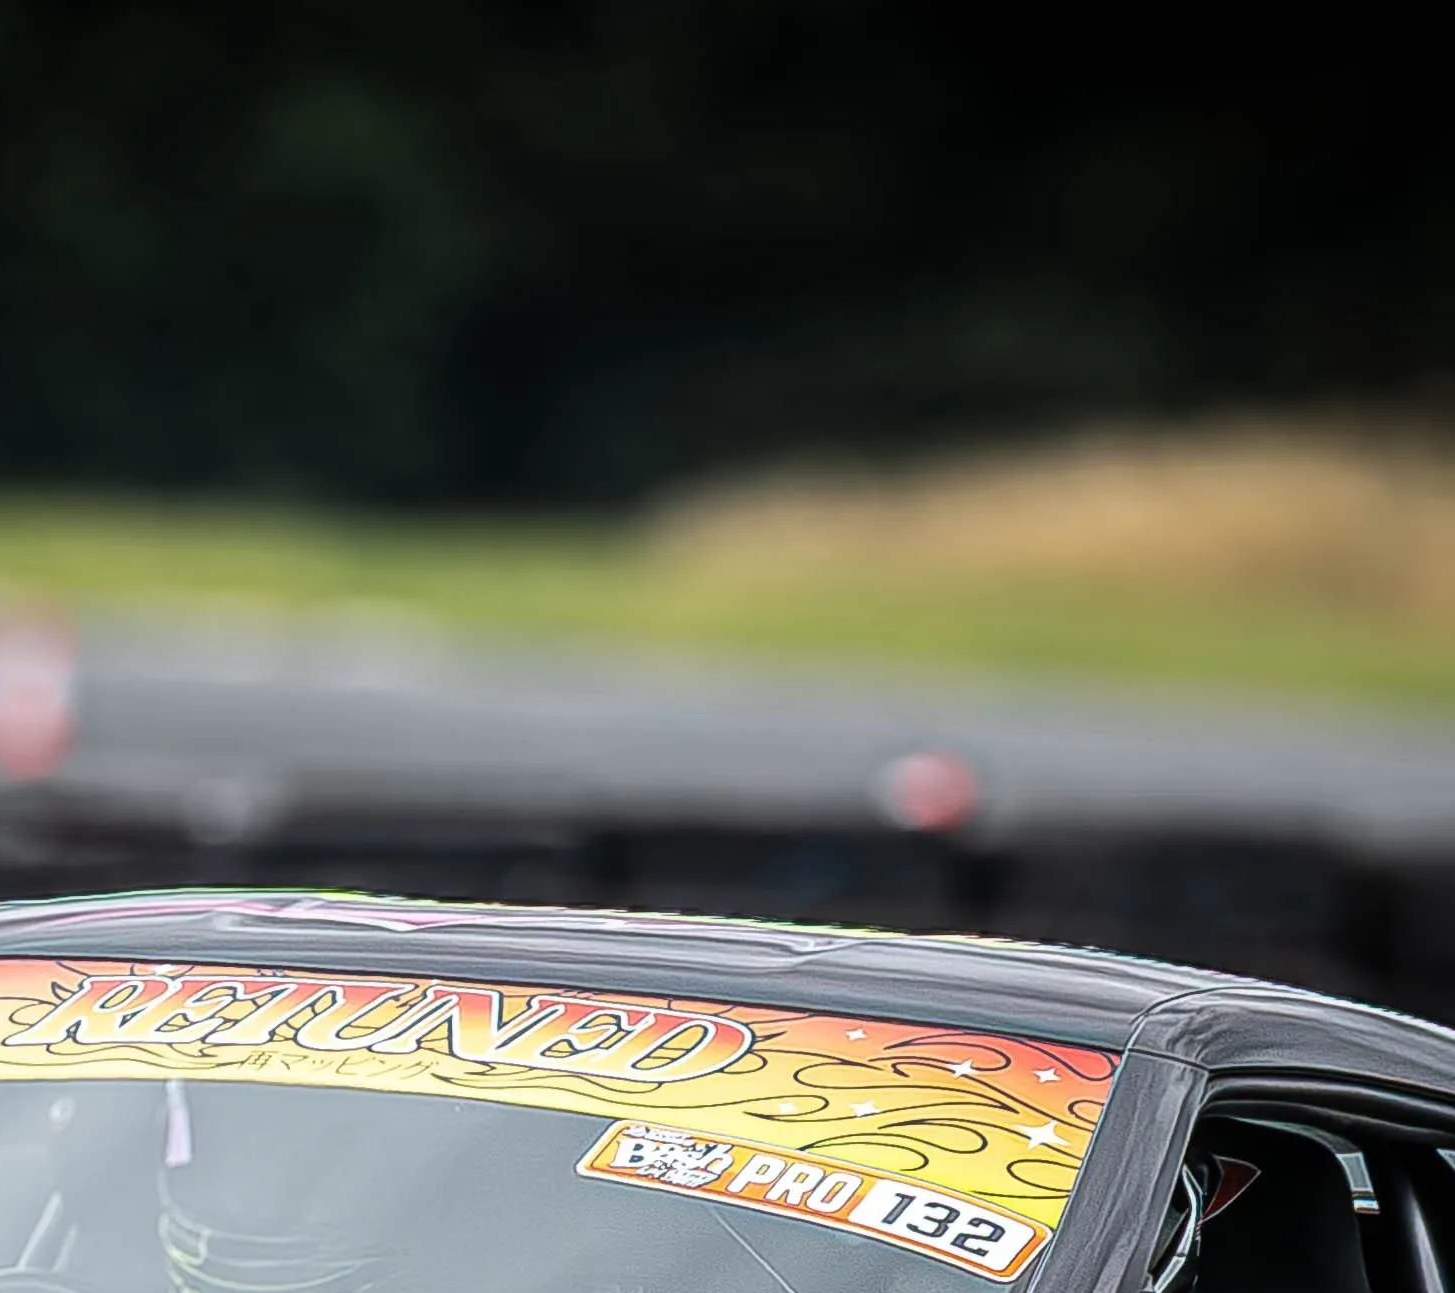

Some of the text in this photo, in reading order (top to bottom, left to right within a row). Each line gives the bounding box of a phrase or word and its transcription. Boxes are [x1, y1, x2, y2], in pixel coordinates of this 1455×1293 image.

[4, 974, 754, 1083] RETUNED
[725, 1153, 1007, 1258] PRO 132
